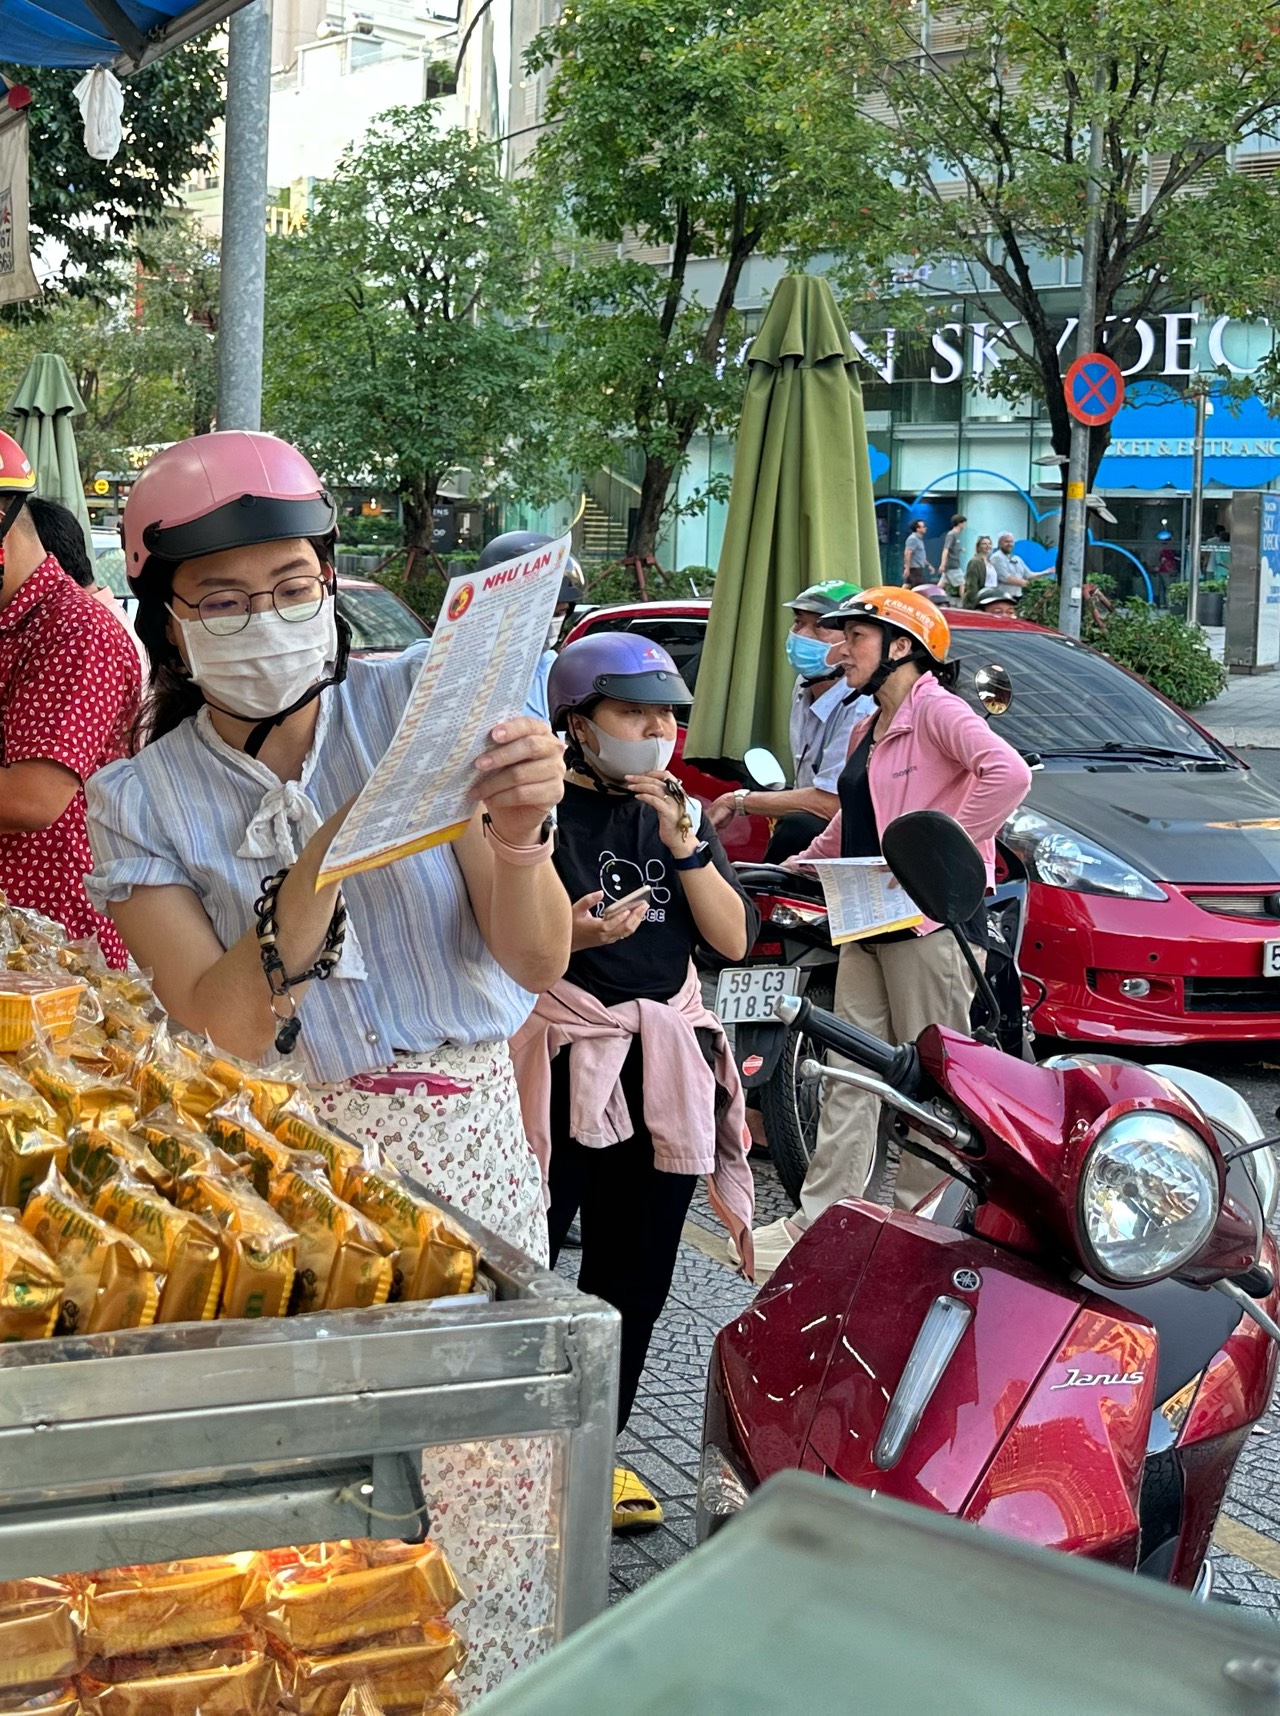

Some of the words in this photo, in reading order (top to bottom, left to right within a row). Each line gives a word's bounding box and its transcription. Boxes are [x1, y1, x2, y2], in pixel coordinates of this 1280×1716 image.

[1109, 440, 1155, 456] KET
[1157, 440, 1172, 456] &
[1263, 533, 1280, 551] DECK
[482, 563, 522, 591] NHƯ
[522, 551, 552, 576] LAN
[729, 971, 786, 994] 59-C3
[720, 995, 776, 1020] 118.5
[1050, 1369, 1145, 1390] Janus
